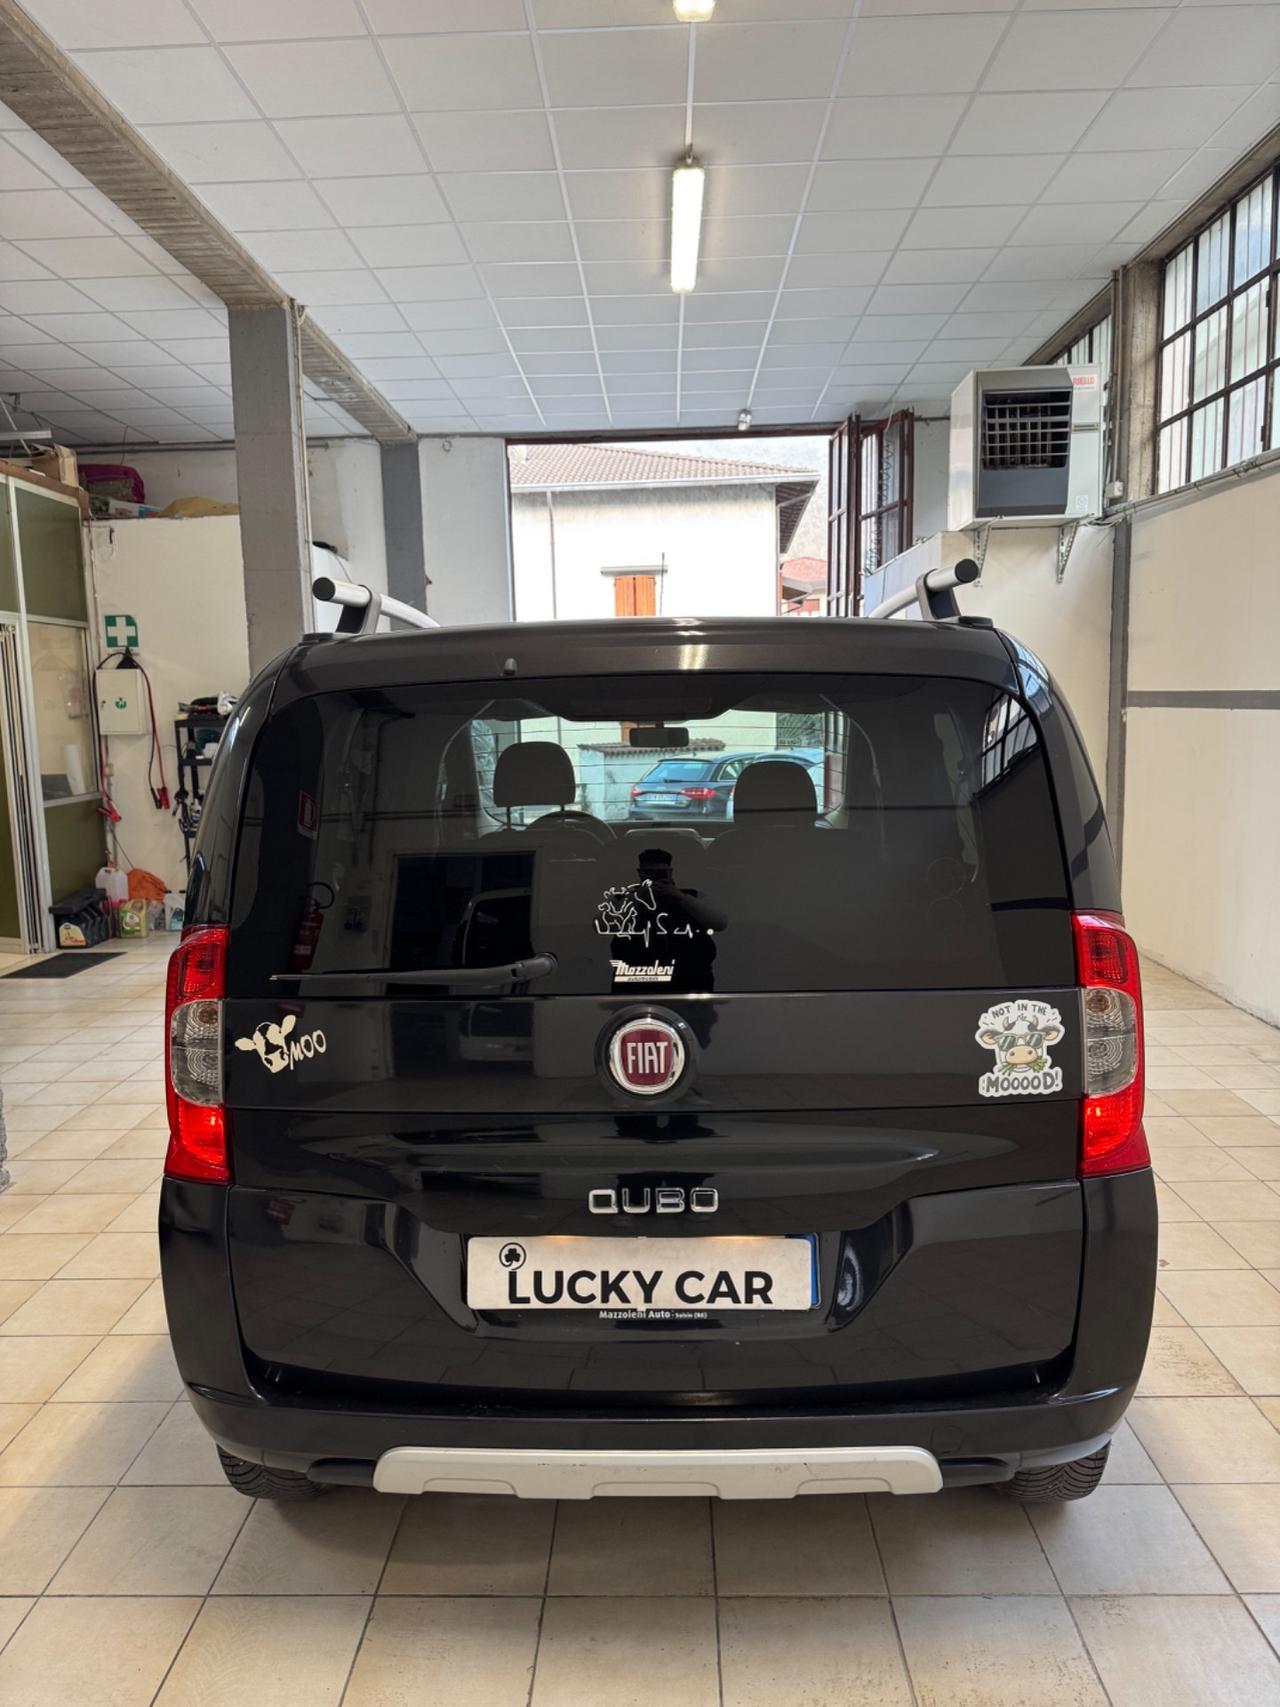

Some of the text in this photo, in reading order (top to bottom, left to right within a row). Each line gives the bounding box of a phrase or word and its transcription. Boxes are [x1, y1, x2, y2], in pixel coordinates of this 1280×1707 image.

[609, 959, 675, 975] Mazzoleni
[991, 1003, 1048, 1019] NOT IN THE
[289, 1029, 327, 1071] MOO
[626, 1041, 669, 1074] FIAT
[588, 1187, 719, 1214] QUBO
[508, 1269, 774, 1305] LUCKY CAR
[599, 1310, 646, 1319] Mazzoleni
[648, 1310, 671, 1319] Auto
